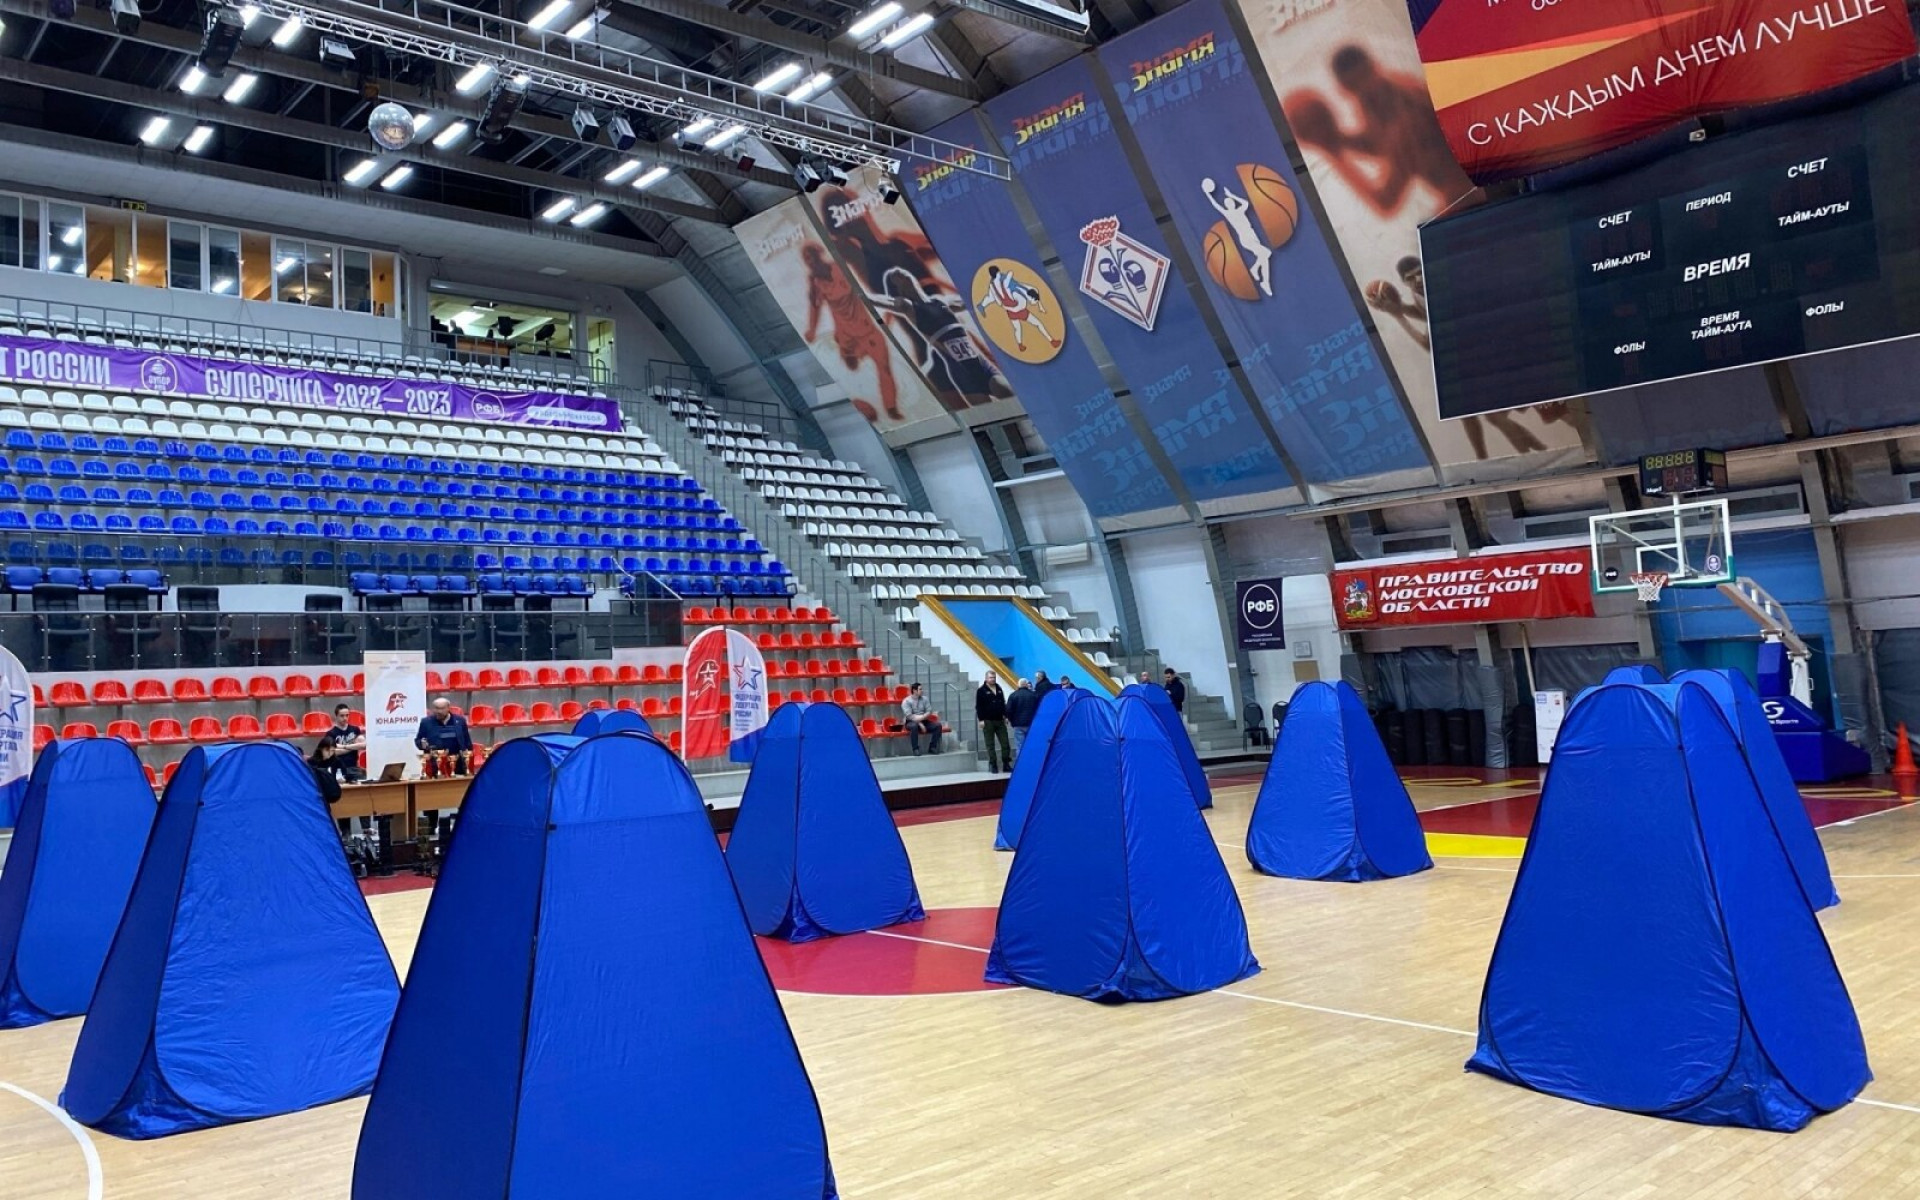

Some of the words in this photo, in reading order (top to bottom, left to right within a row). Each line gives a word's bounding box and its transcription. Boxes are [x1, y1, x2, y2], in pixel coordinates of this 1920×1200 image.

[1468, 123, 1492, 145] С
[1494, 65, 1646, 138] КАЖДЫМ
[1653, 29, 1747, 86] ДНЕМ
[1755, 0, 1886, 50] ЛУЧШЕ
[1787, 157, 1829, 179] СЧЕТ
[1685, 191, 1732, 213] ПЕРИОД
[1598, 210, 1633, 230] СЧЕТ
[1778, 201, 1850, 227] ТАЙМ-АУТЫ
[1592, 250, 1651, 273] ТАЙМ-АУТЫ
[1683, 252, 1752, 283] ВРЕМЯ
[1700, 310, 1741, 328] ВРЕМЯ
[1805, 301, 1844, 318] ФОЛЫ
[1691, 319, 1753, 341] ТАЙМ-АУТА
[1613, 340, 1646, 356] ФОЛЫ
[15, 347, 111, 385] РОССИИ
[205, 368, 326, 406] СУПЕРЛИГА
[1378, 562, 1584, 588] ПРАВИТЕЛЬСТВО
[1379, 576, 1540, 602] МОСКОВСКОЙ
[1247, 599, 1275, 613] РФБ
[1381, 596, 1492, 615] ОБЛАСТИ
[375, 716, 419, 725] ЮНАРМИЯ
